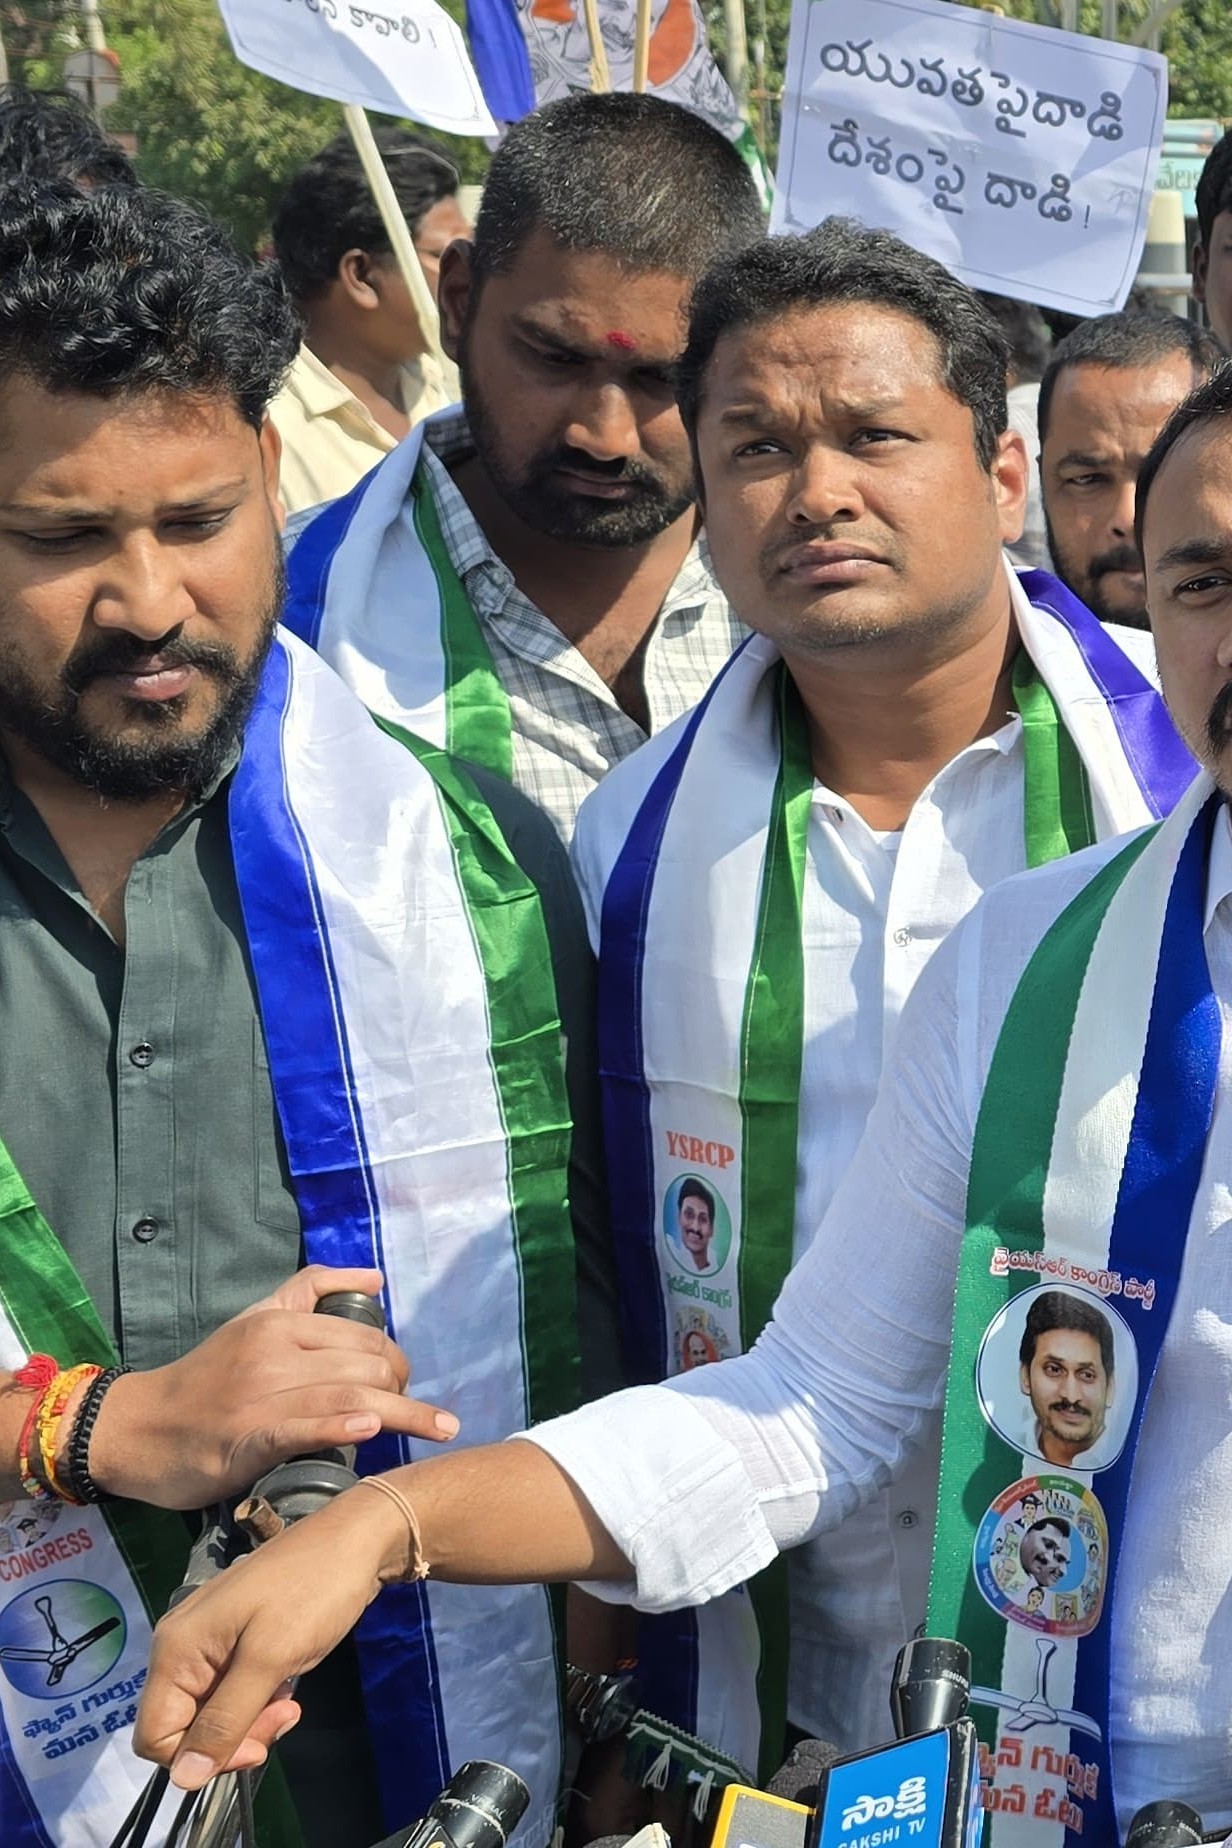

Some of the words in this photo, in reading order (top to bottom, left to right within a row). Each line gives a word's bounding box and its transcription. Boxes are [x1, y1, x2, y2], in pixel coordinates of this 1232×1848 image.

[827, 119, 966, 214] దేశంపై
[665, 1130, 735, 1170] YSRCP
[0, 1527, 95, 1582] CONGRESS
[42, 1727, 100, 1760] మన
[841, 1776, 926, 1831] సాక్షి
[907, 1818, 927, 1836] TV
